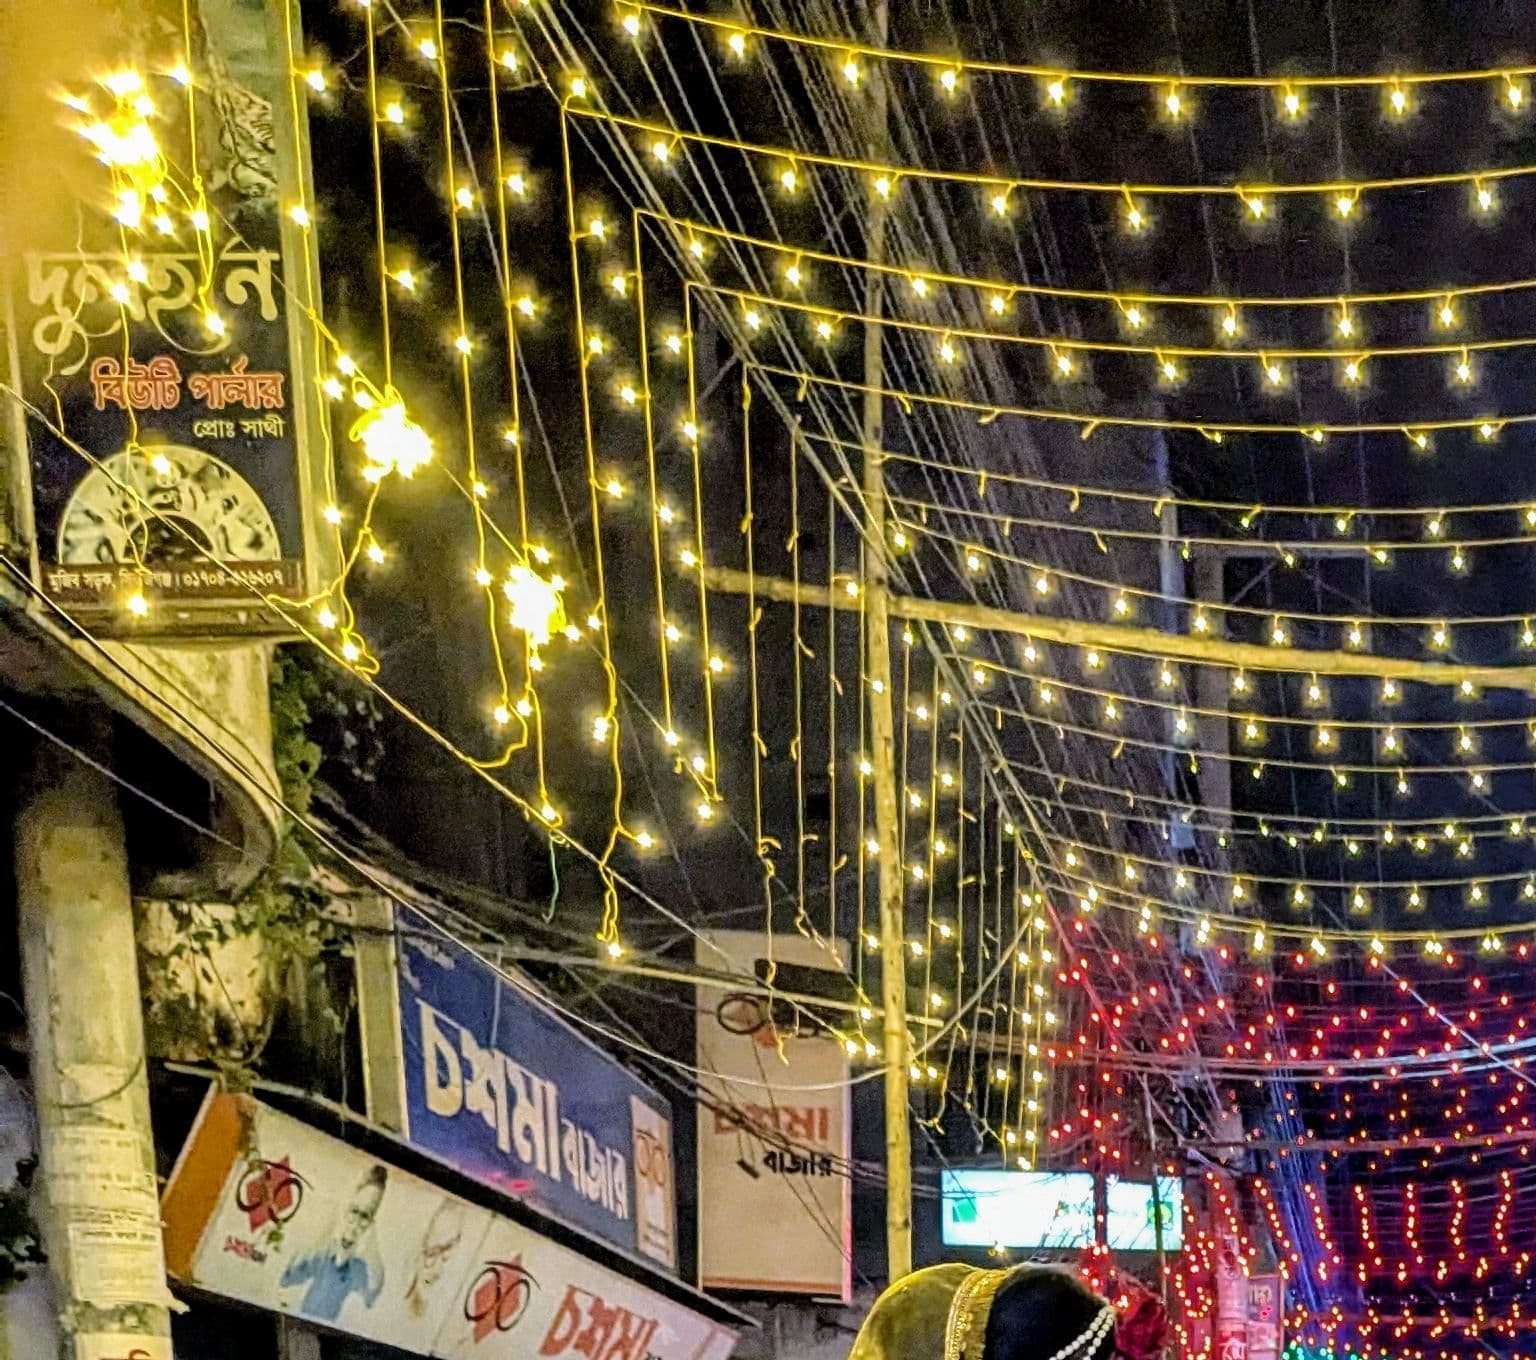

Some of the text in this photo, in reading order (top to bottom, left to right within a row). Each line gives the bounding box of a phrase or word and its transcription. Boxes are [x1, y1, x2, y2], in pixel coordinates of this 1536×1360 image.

[91, 353, 284, 410] বিউটি পার্লার
[415, 998, 629, 1221] চশমা বাজার
[763, 1150, 832, 1177] বাজার
